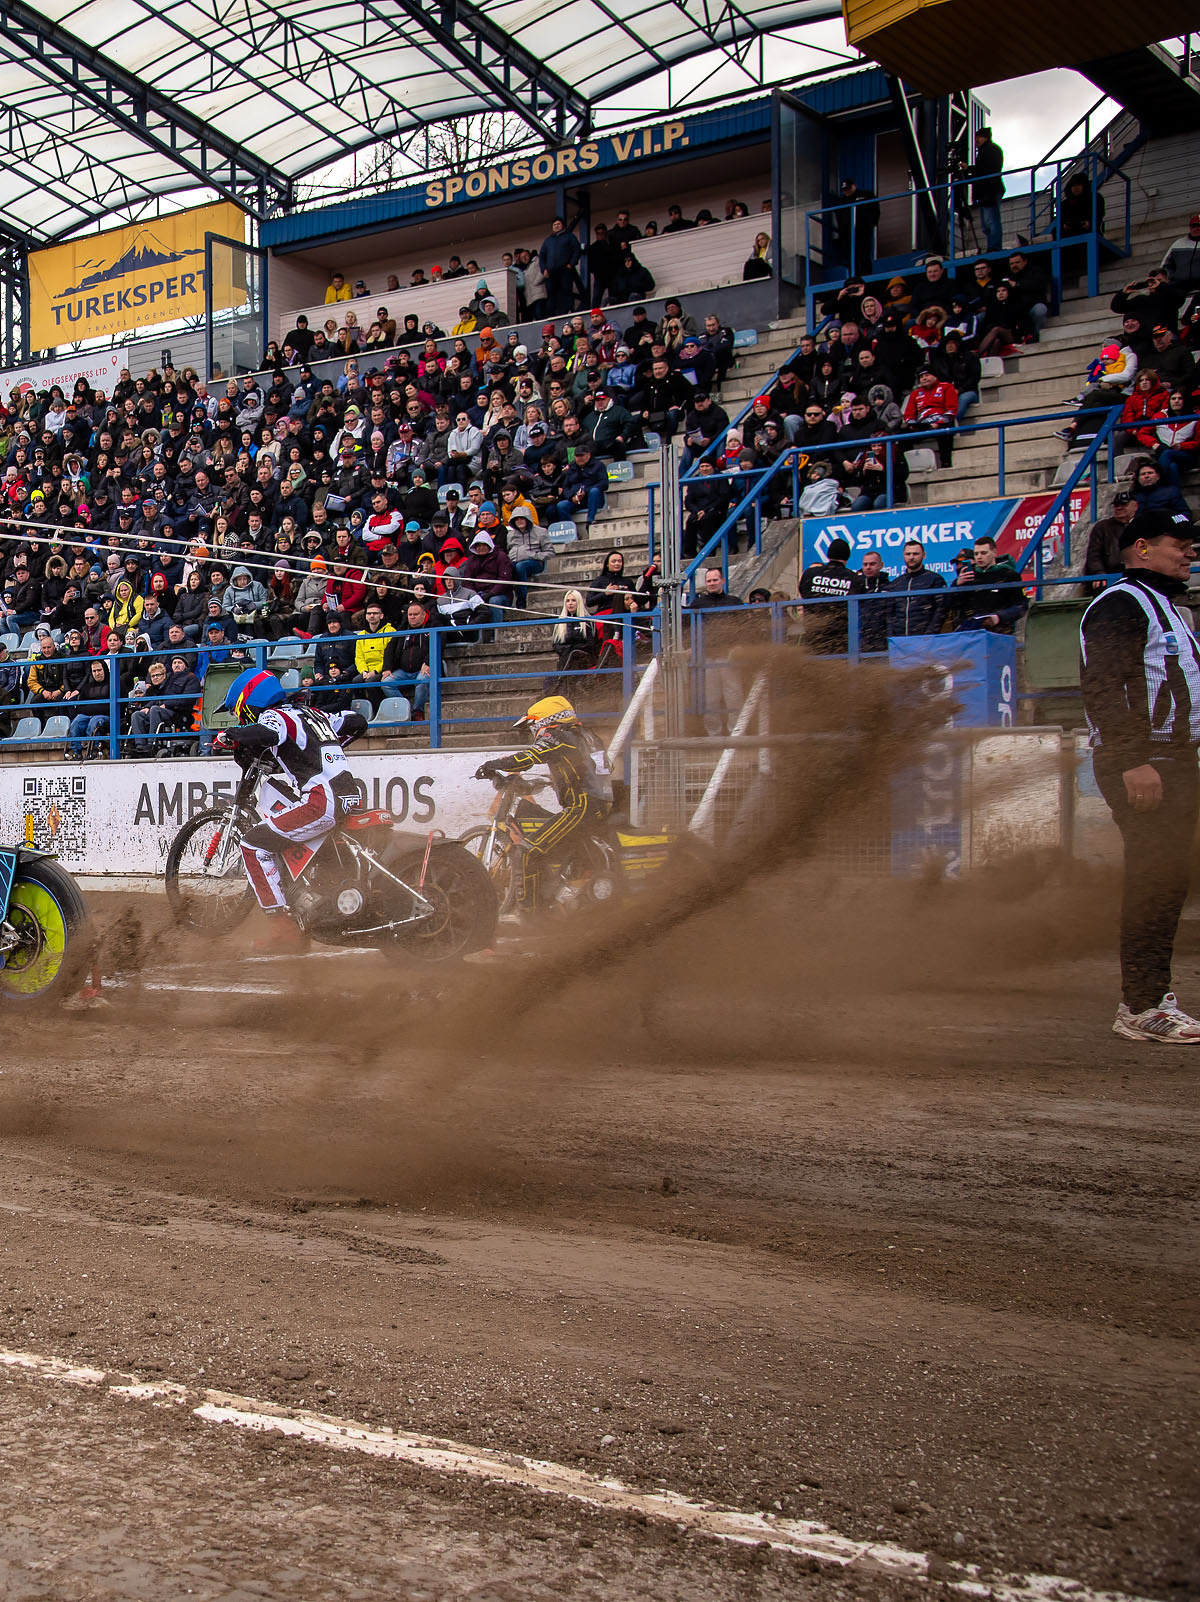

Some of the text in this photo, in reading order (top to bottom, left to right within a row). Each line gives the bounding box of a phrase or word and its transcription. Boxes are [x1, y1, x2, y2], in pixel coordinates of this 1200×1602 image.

[425, 122, 690, 207] SPONSORS V.I.P.
[51, 270, 207, 326] TUREKSPERT
[88, 306, 181, 334] TRAVEL AGENCY
[42, 371, 94, 388] OLEGSEXPRESS
[96, 367, 108, 379] LTD
[1024, 511, 1080, 528] ORINAL
[856, 520, 975, 550] STOKKER
[810, 585, 849, 597] SECURITY
[812, 575, 852, 590] GROM
[134, 776, 436, 826] AMBE DIOS
